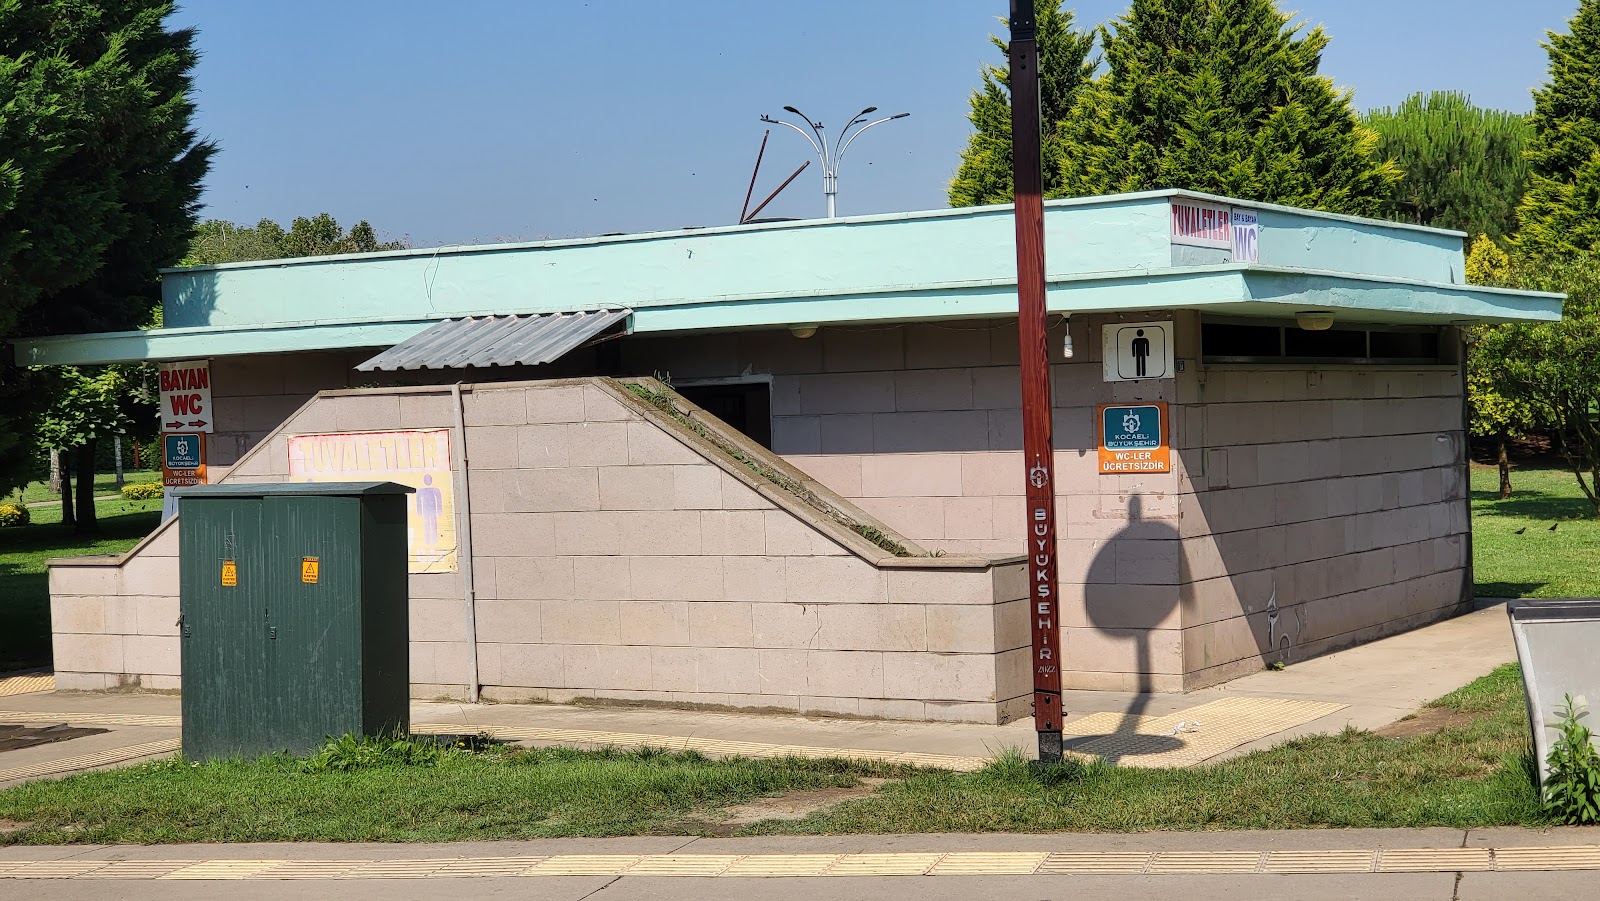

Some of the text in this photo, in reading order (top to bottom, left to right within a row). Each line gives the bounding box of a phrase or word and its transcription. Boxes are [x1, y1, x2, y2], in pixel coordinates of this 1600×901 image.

[1172, 204, 1230, 241] TUVALETLER
[1245, 214, 1257, 223] BAYAN
[1234, 226, 1257, 261] WC
[160, 367, 209, 392] BAYAN
[170, 393, 203, 416] WC
[299, 437, 439, 472] TUVALETLER
[1103, 460, 1164, 471] ÜCRETSİZDİR
[1115, 452, 1151, 460] WC-LER
[1034, 508, 1052, 660] BÜYÜKŞEHİR
